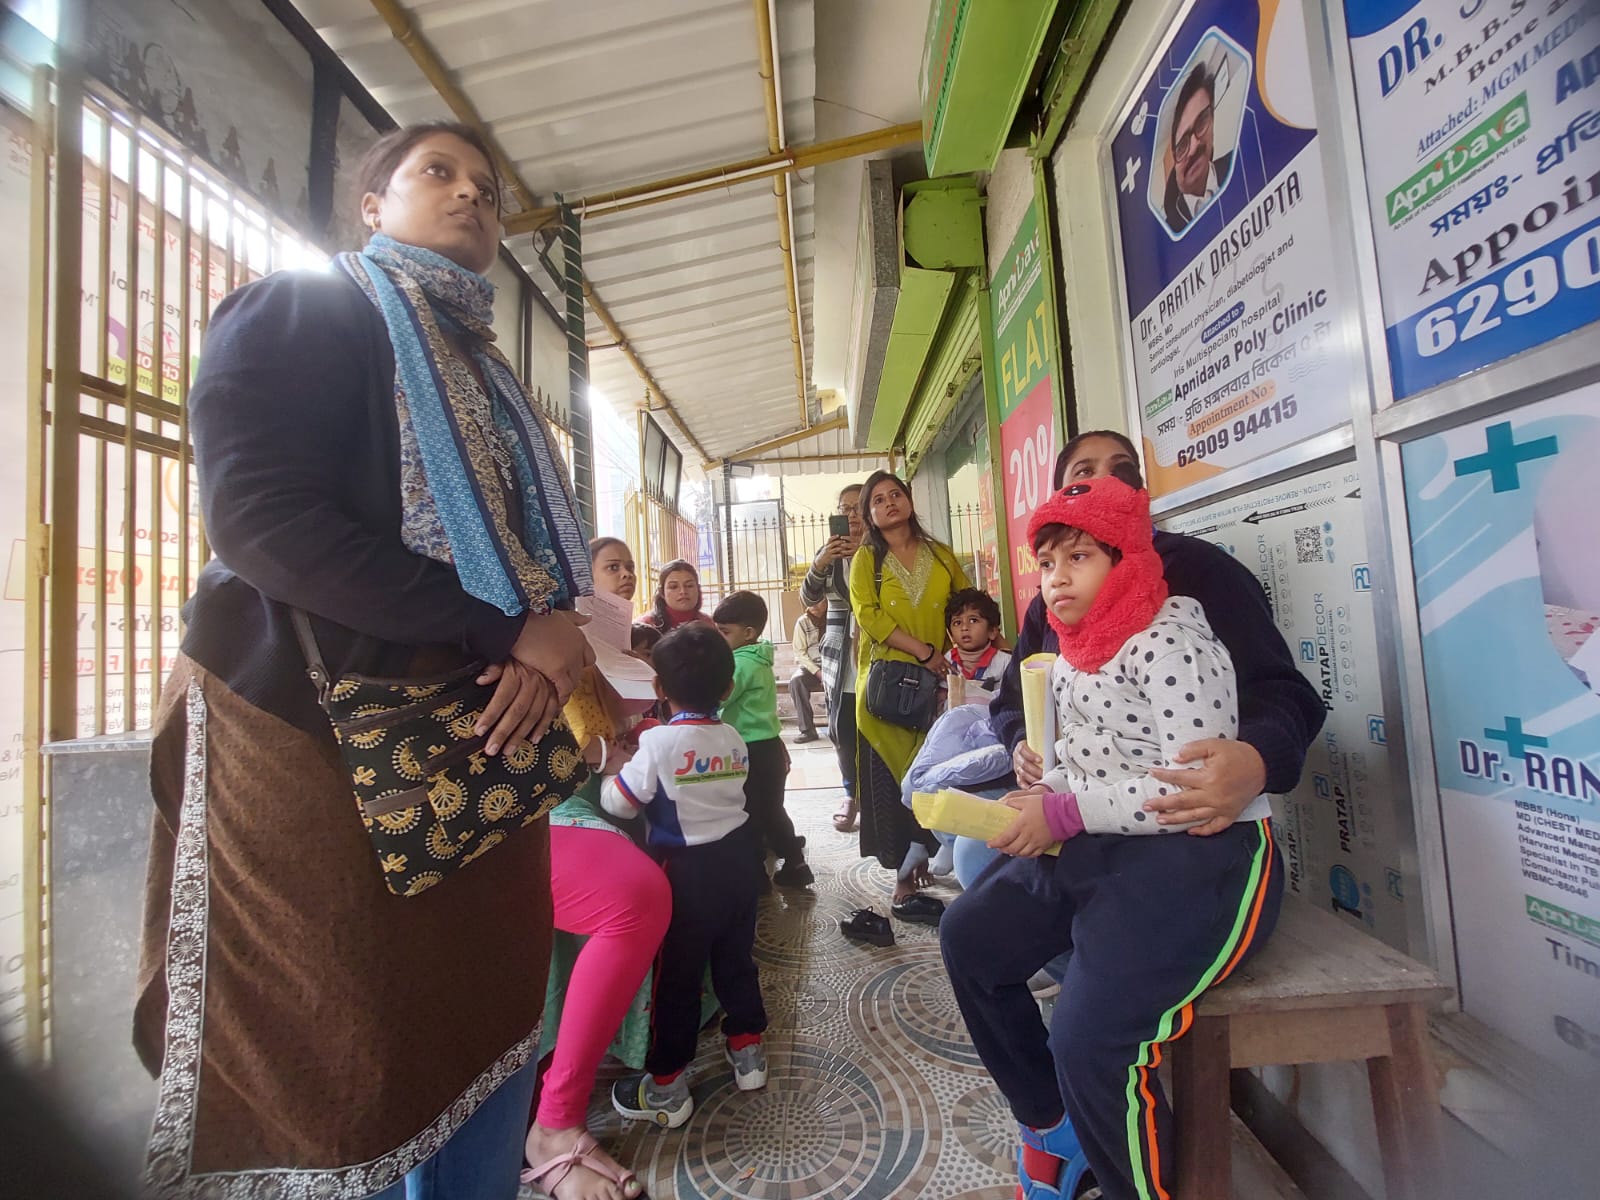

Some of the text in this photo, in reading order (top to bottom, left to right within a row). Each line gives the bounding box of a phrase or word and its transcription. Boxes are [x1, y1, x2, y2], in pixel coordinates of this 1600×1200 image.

[1378, 17, 1443, 98] DR.
[1468, 17, 1538, 85] Bone
[1416, 96, 1478, 157] Attached:
[1481, 52, 1528, 105] MGM
[1140, 171, 1302, 343] Dr. PRATIK DASGUPTA
[1165, 325, 1194, 354] consultant
[1193, 297, 1226, 331] physician,
[1226, 253, 1277, 298] diabetologist
[1277, 235, 1294, 258] and
[1174, 288, 1328, 402] Apnidava Poly Clinic
[1186, 326, 1239, 370] Multispecialty
[1241, 292, 1281, 330] hospital
[1203, 311, 1231, 341] Attached
[1002, 300, 1049, 409] FLAT
[1251, 342, 1297, 383] বিকেল
[1177, 394, 1298, 468] 62909 94415
[1188, 394, 1249, 437] Appointment
[1250, 384, 1268, 403] No
[1242, 495, 1275, 511] PROTECTIVE
[1274, 489, 1299, 503] REMOVE
[1460, 740, 1511, 782] Dr.
[1515, 800, 1580, 825] MBBS (Hons)
[1516, 811, 1531, 822] MD
[1534, 816, 1573, 833] (CHEST
[1518, 823, 1566, 843] Advanced
[1519, 834, 1560, 854] (Harvard
[1520, 845, 1568, 868] Specialist
[1570, 860, 1580, 872] in
[1521, 857, 1579, 884] (Consultant
